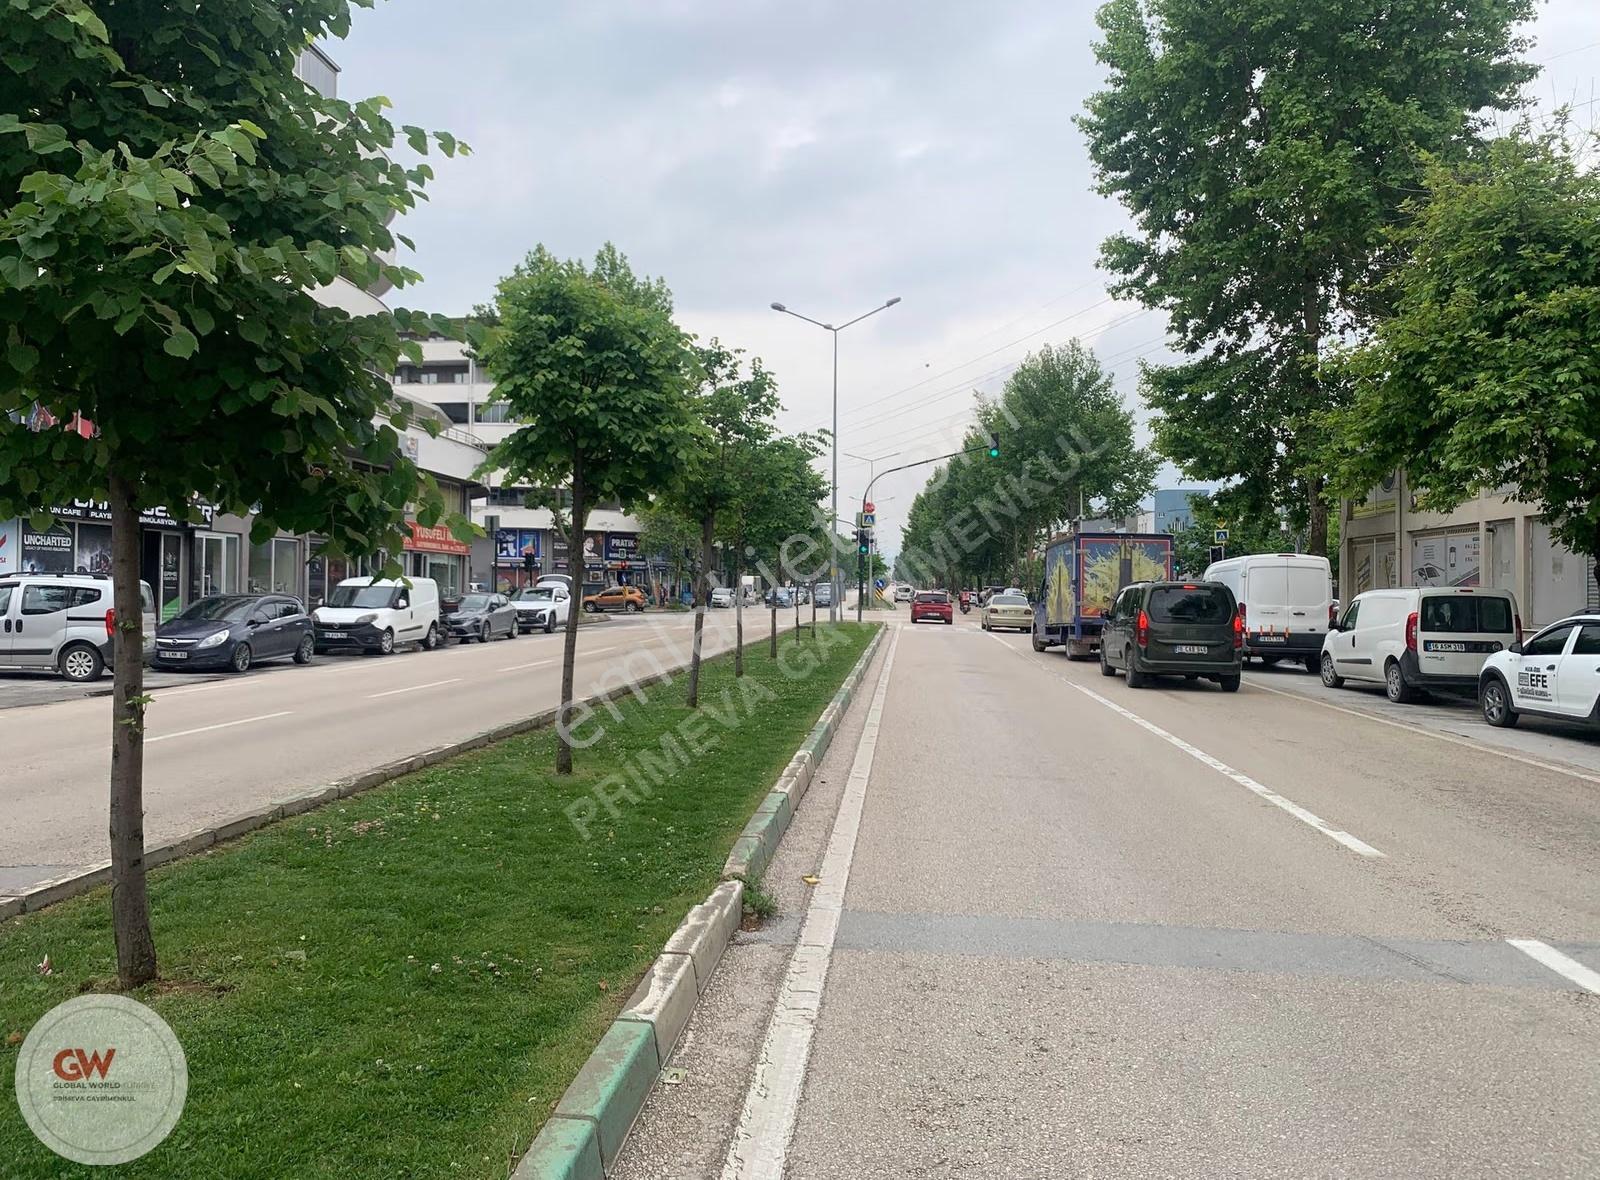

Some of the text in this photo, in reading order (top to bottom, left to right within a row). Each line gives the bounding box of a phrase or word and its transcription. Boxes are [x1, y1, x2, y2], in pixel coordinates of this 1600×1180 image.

[62, 508, 81, 516] CAFE
[24, 534, 71, 547] UNCHARTED
[1530, 673, 1548, 688] EFE
